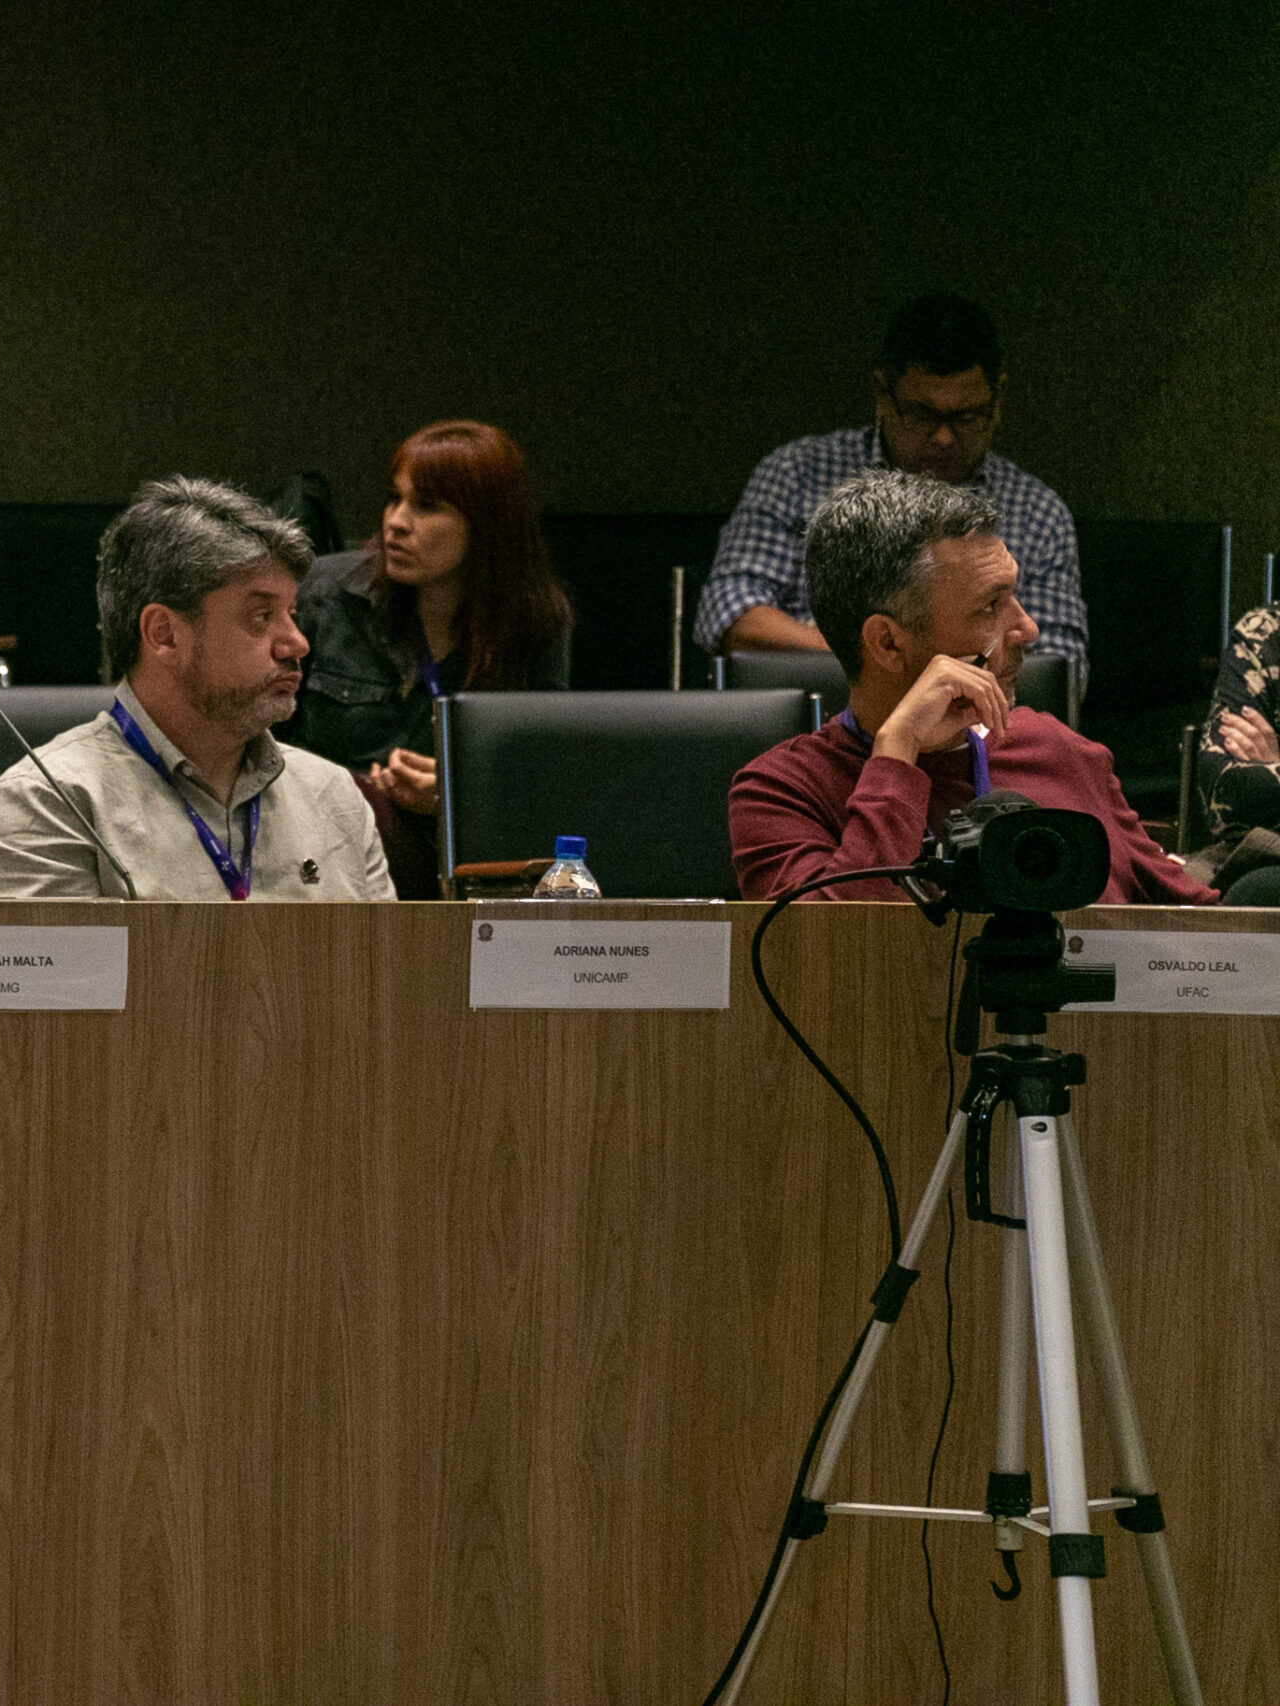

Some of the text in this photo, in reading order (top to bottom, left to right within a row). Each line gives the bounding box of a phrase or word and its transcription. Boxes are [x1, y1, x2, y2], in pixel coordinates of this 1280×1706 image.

[553, 946, 650, 957] ADRIANA NUNES
[12, 955, 54, 967] MALTA
[1148, 960, 1239, 973] OSVALDO LEAL
[573, 972, 628, 984] UNICAMP
[1176, 986, 1210, 998] UFAC
